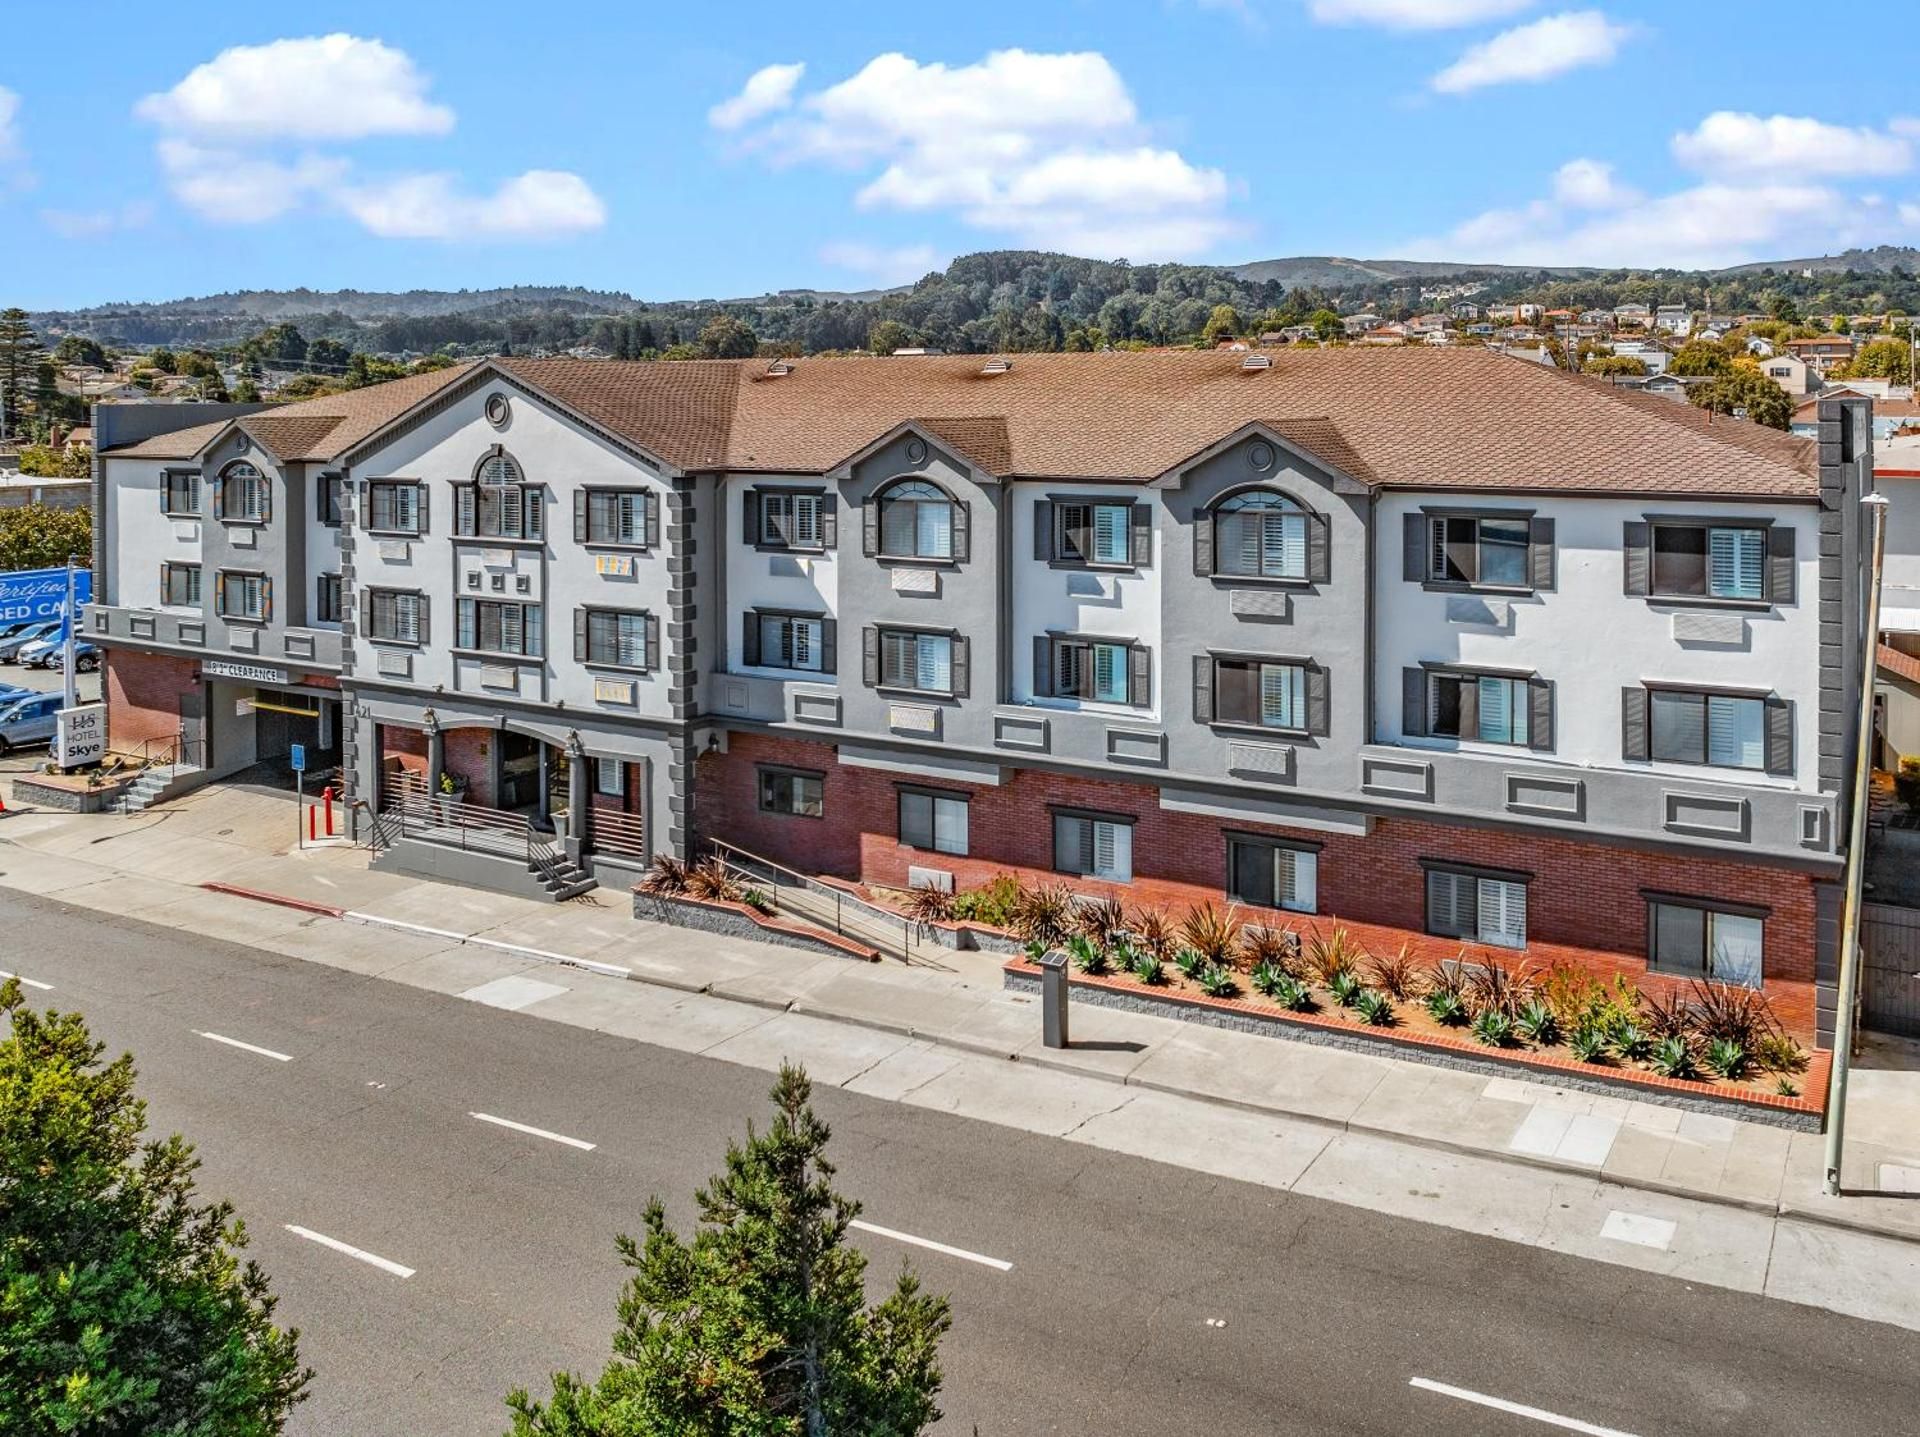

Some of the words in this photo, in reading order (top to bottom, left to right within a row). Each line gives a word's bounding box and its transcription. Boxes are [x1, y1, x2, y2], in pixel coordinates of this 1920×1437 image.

[37, 599, 84, 617] CAS
[228, 664, 277, 681] CLEARANCE
[67, 730, 101, 743] HOTEL
[69, 744, 100, 757] Skye
